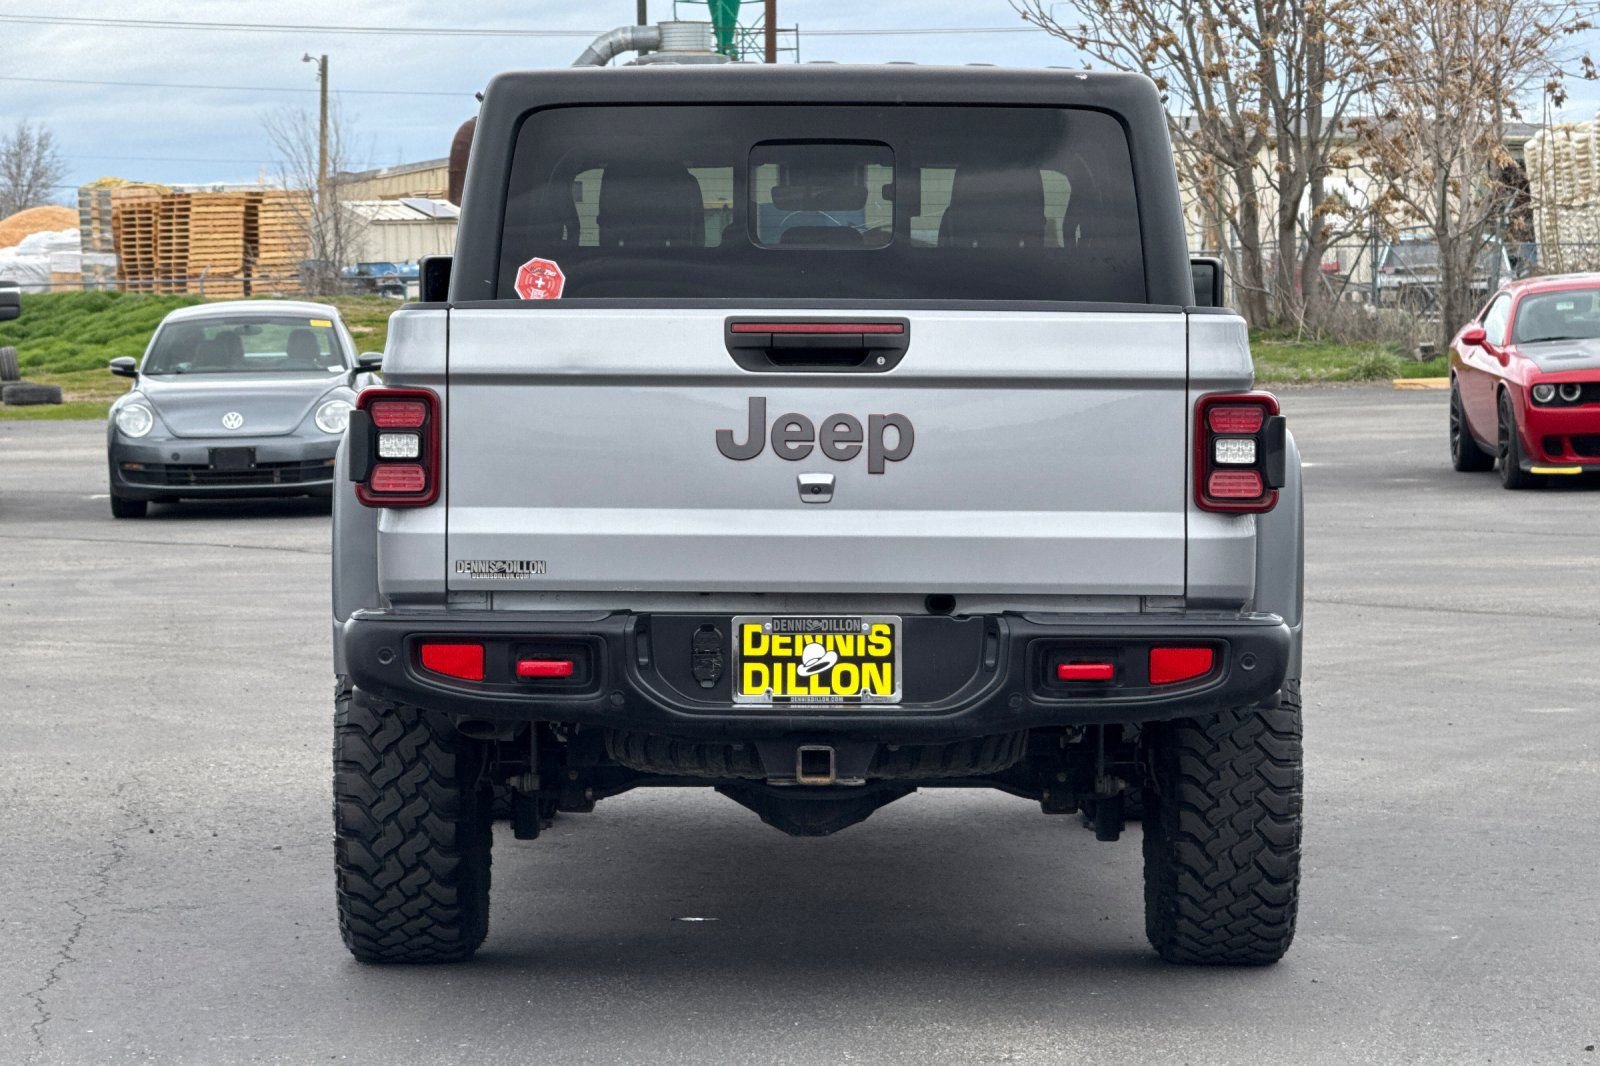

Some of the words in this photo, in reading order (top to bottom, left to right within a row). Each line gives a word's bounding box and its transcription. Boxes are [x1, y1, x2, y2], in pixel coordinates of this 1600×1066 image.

[716, 397, 915, 475] Jeep
[456, 560, 496, 573] DENNIS
[505, 560, 546, 574] DILLON
[773, 619, 813, 632] DENNIS
[821, 619, 861, 632] DILLON
[743, 662, 892, 695] DILLON
